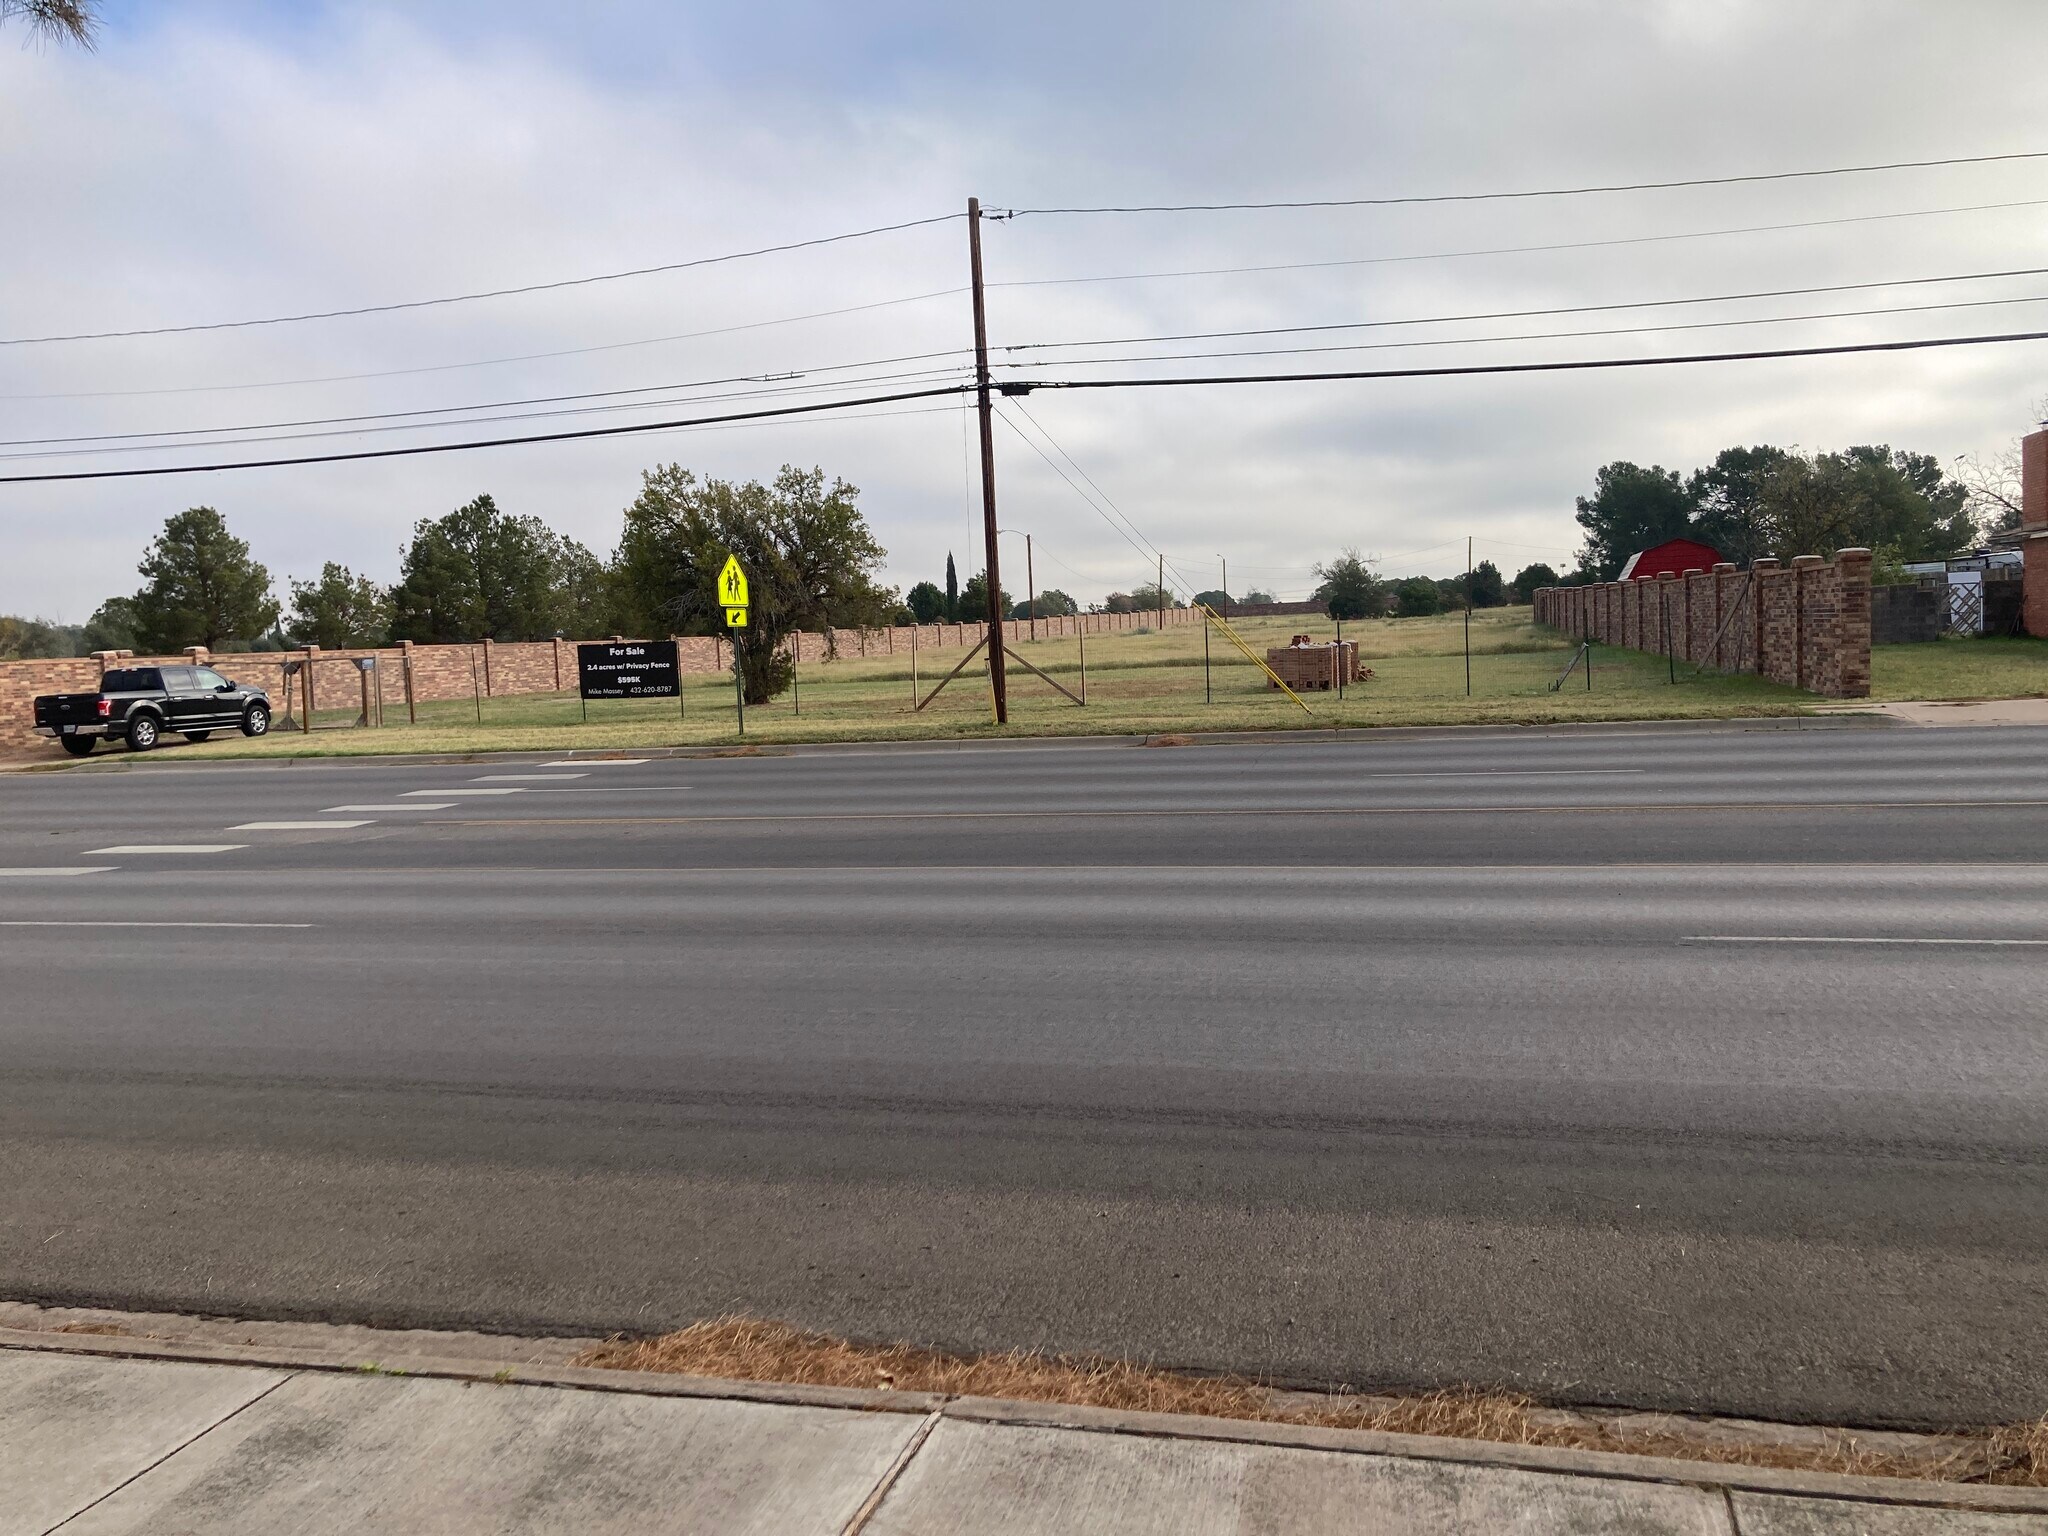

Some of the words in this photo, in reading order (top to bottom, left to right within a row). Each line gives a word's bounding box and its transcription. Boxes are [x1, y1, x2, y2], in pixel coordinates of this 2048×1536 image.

[609, 648, 624, 656] For
[626, 647, 645, 655] Sale
[626, 662, 649, 670] Privacy
[617, 676, 641, 684] $595K
